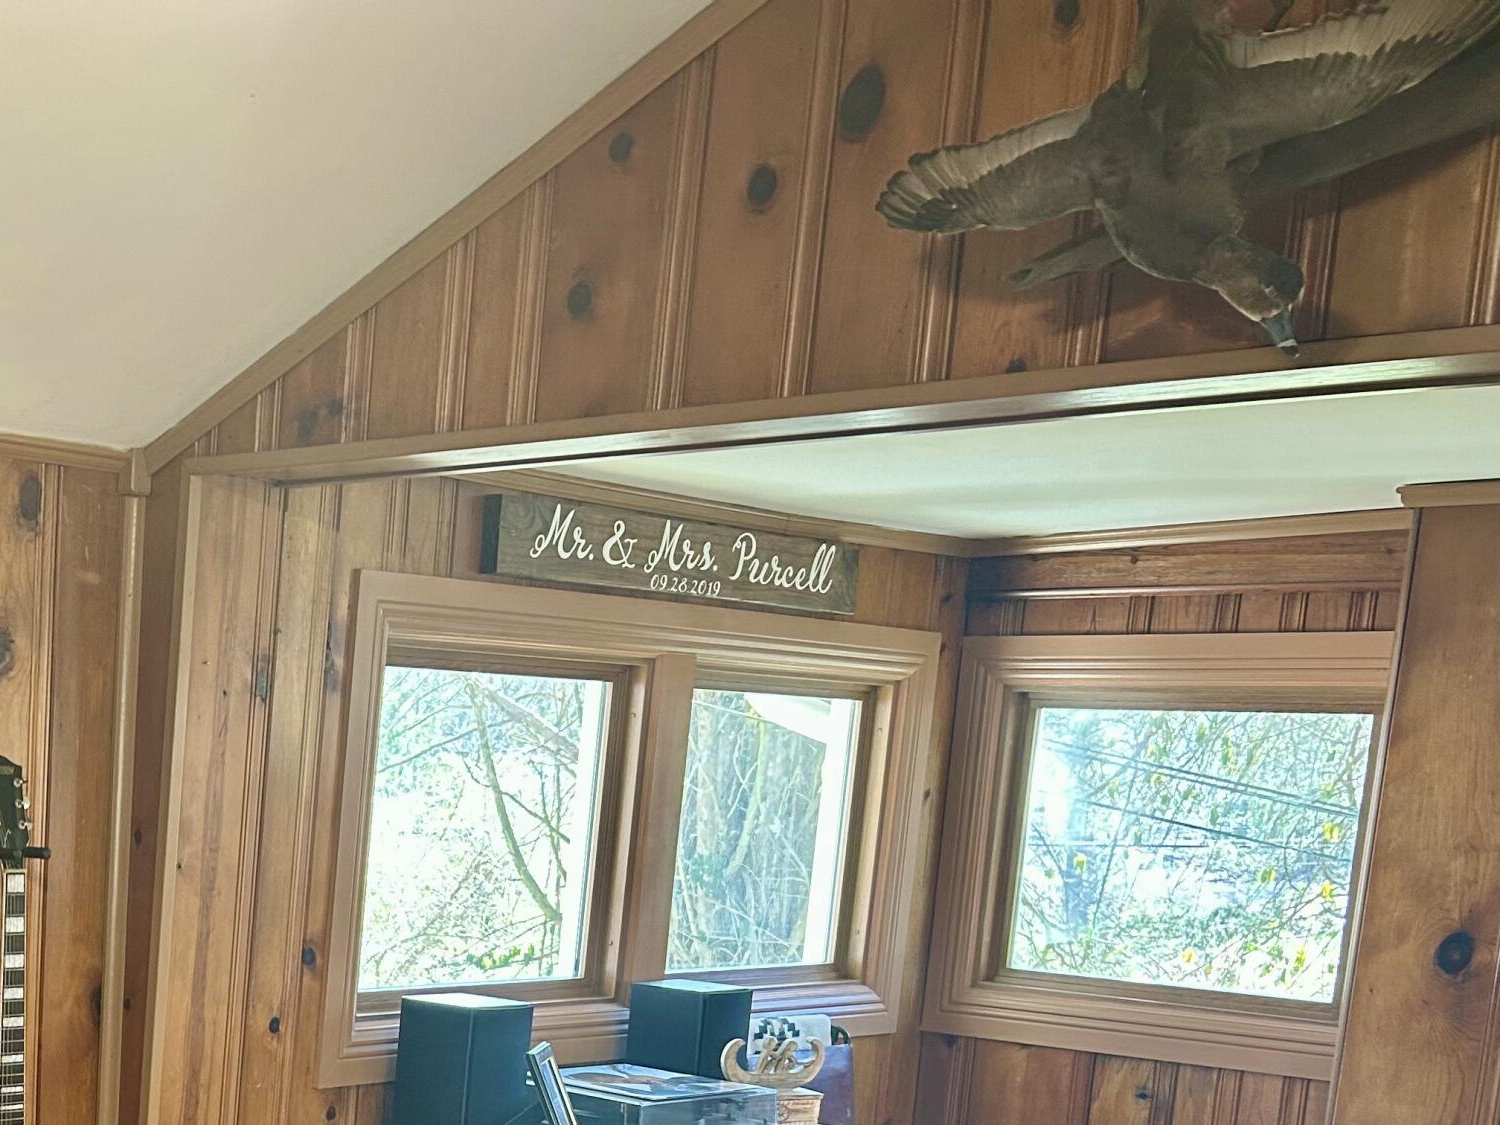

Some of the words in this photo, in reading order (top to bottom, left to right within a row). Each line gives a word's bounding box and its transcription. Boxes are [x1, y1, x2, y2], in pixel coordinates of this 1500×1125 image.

[529, 504, 594, 560] Mr.
[602, 520, 638, 568] &
[644, 520, 718, 573] Mrs.
[729, 532, 836, 594] Purcell
[650, 574, 721, 597] 09.28.2019
